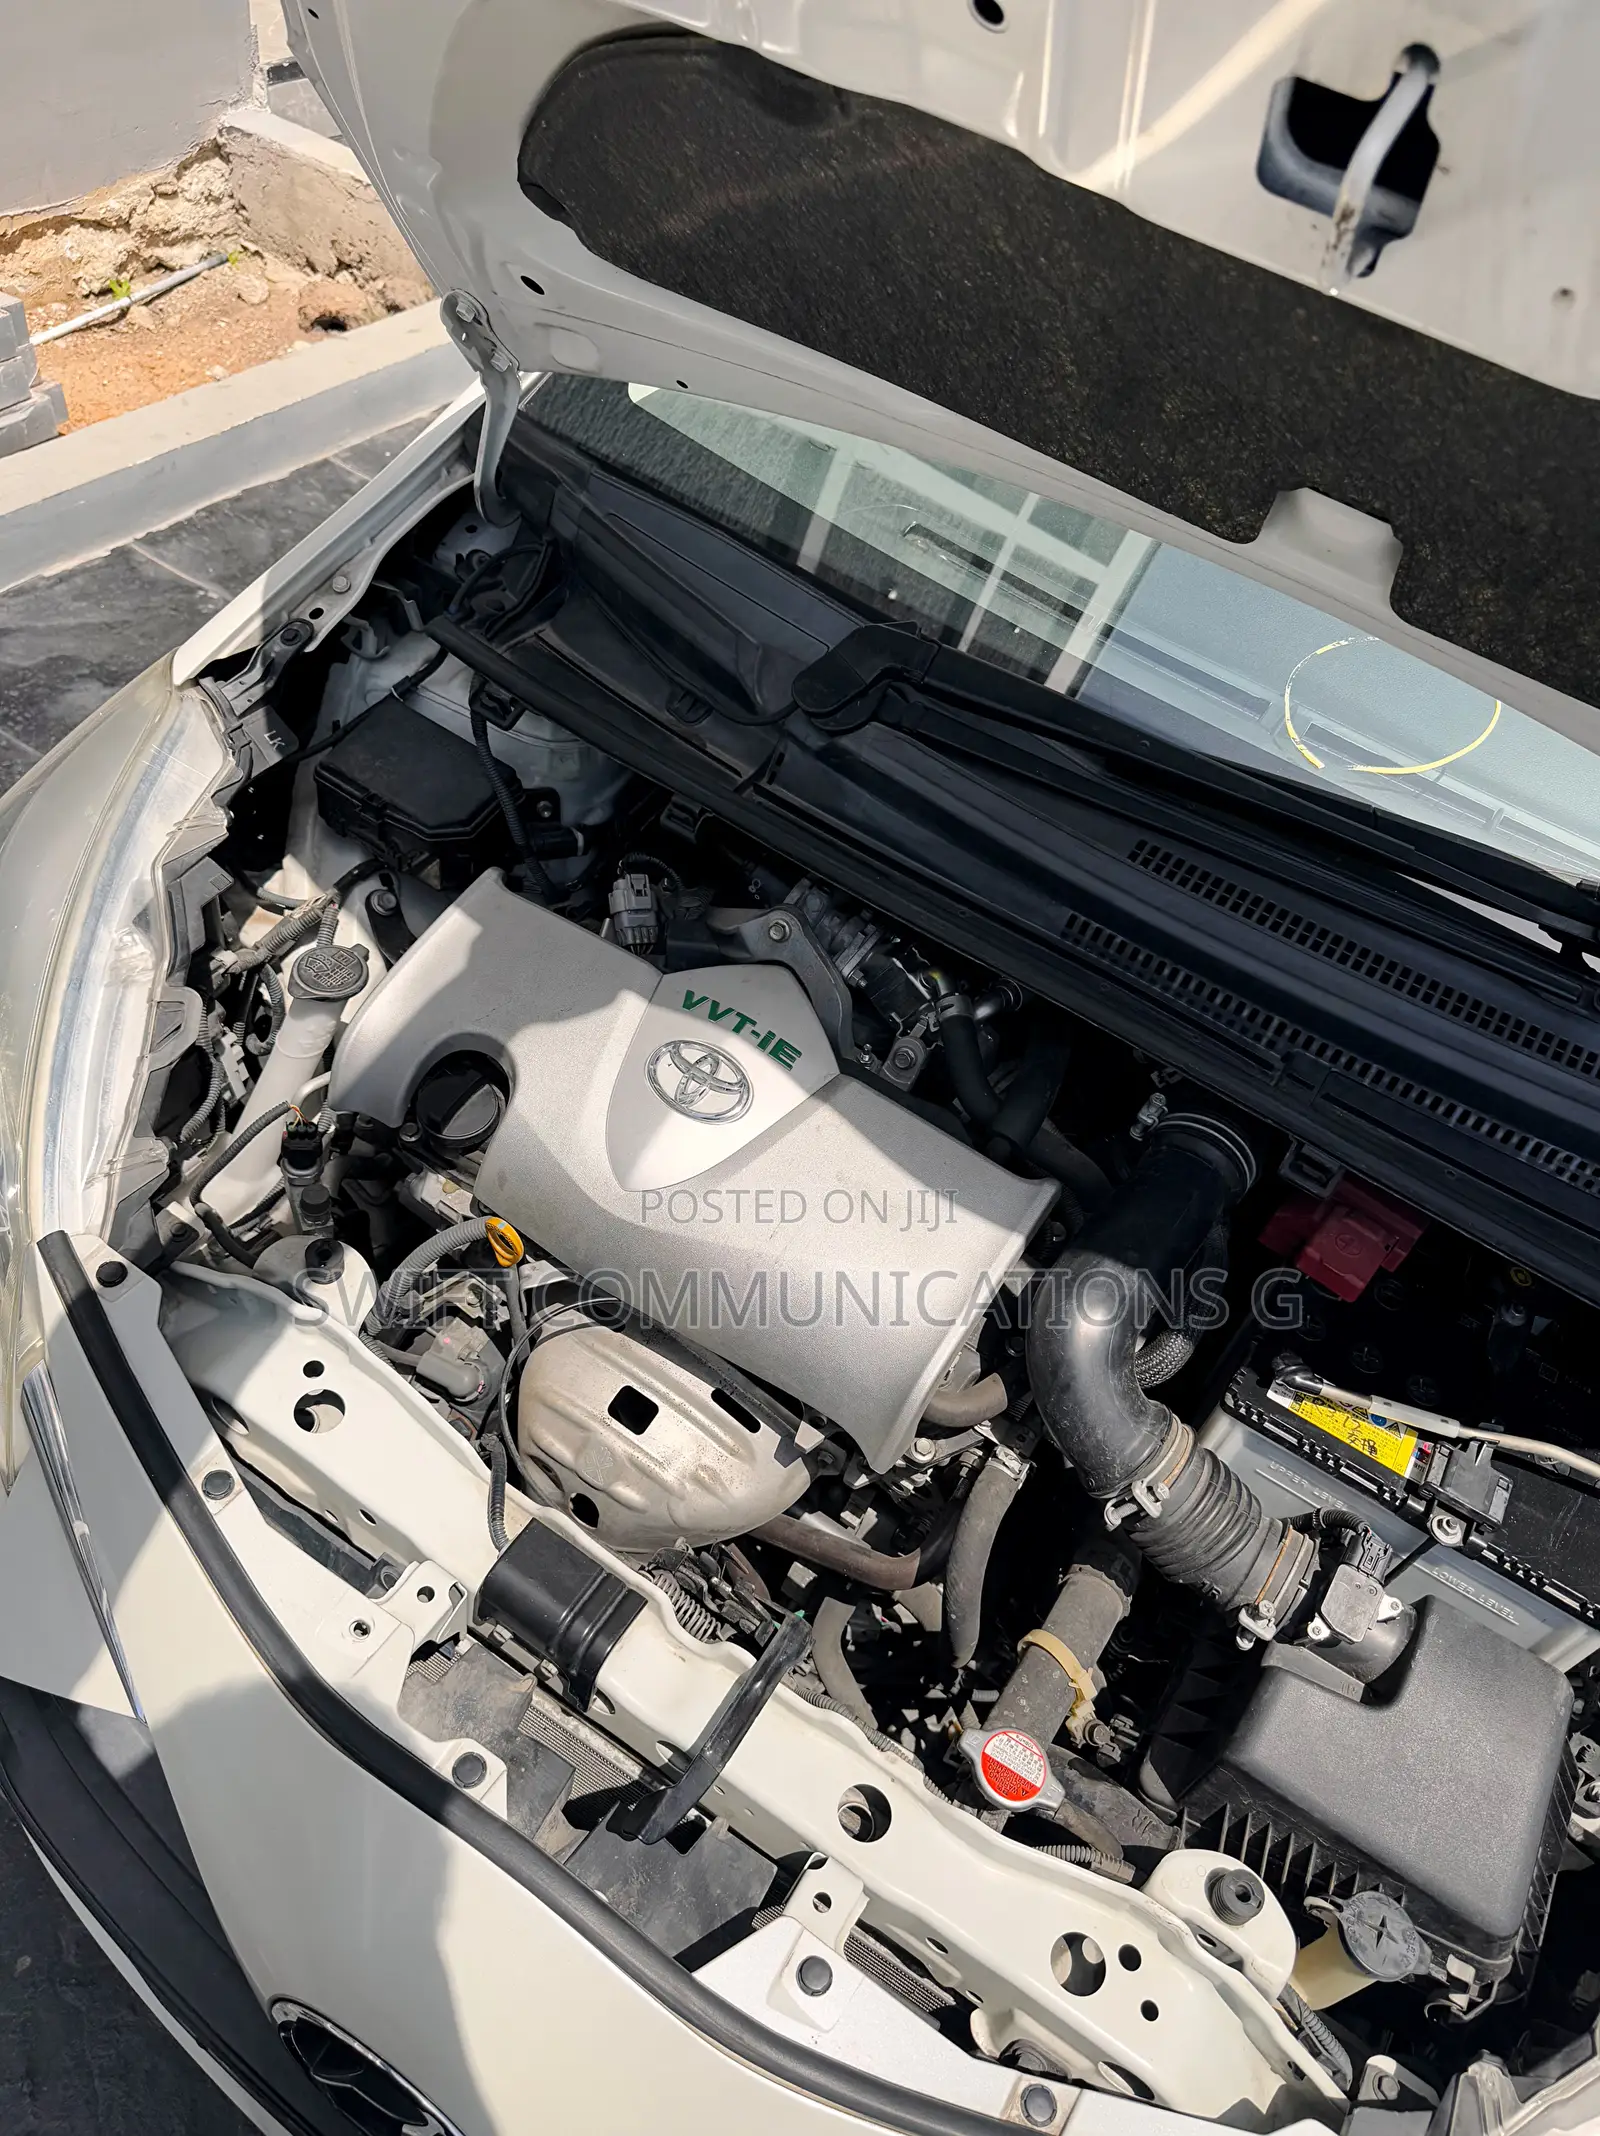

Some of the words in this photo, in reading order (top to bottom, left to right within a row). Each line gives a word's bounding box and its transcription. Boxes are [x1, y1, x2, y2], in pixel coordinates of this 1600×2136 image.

[1269, 1461, 1309, 1488] UPPER
[1431, 1566, 1476, 1596] LOWER
[1478, 1593, 1516, 1620] LEVEL
